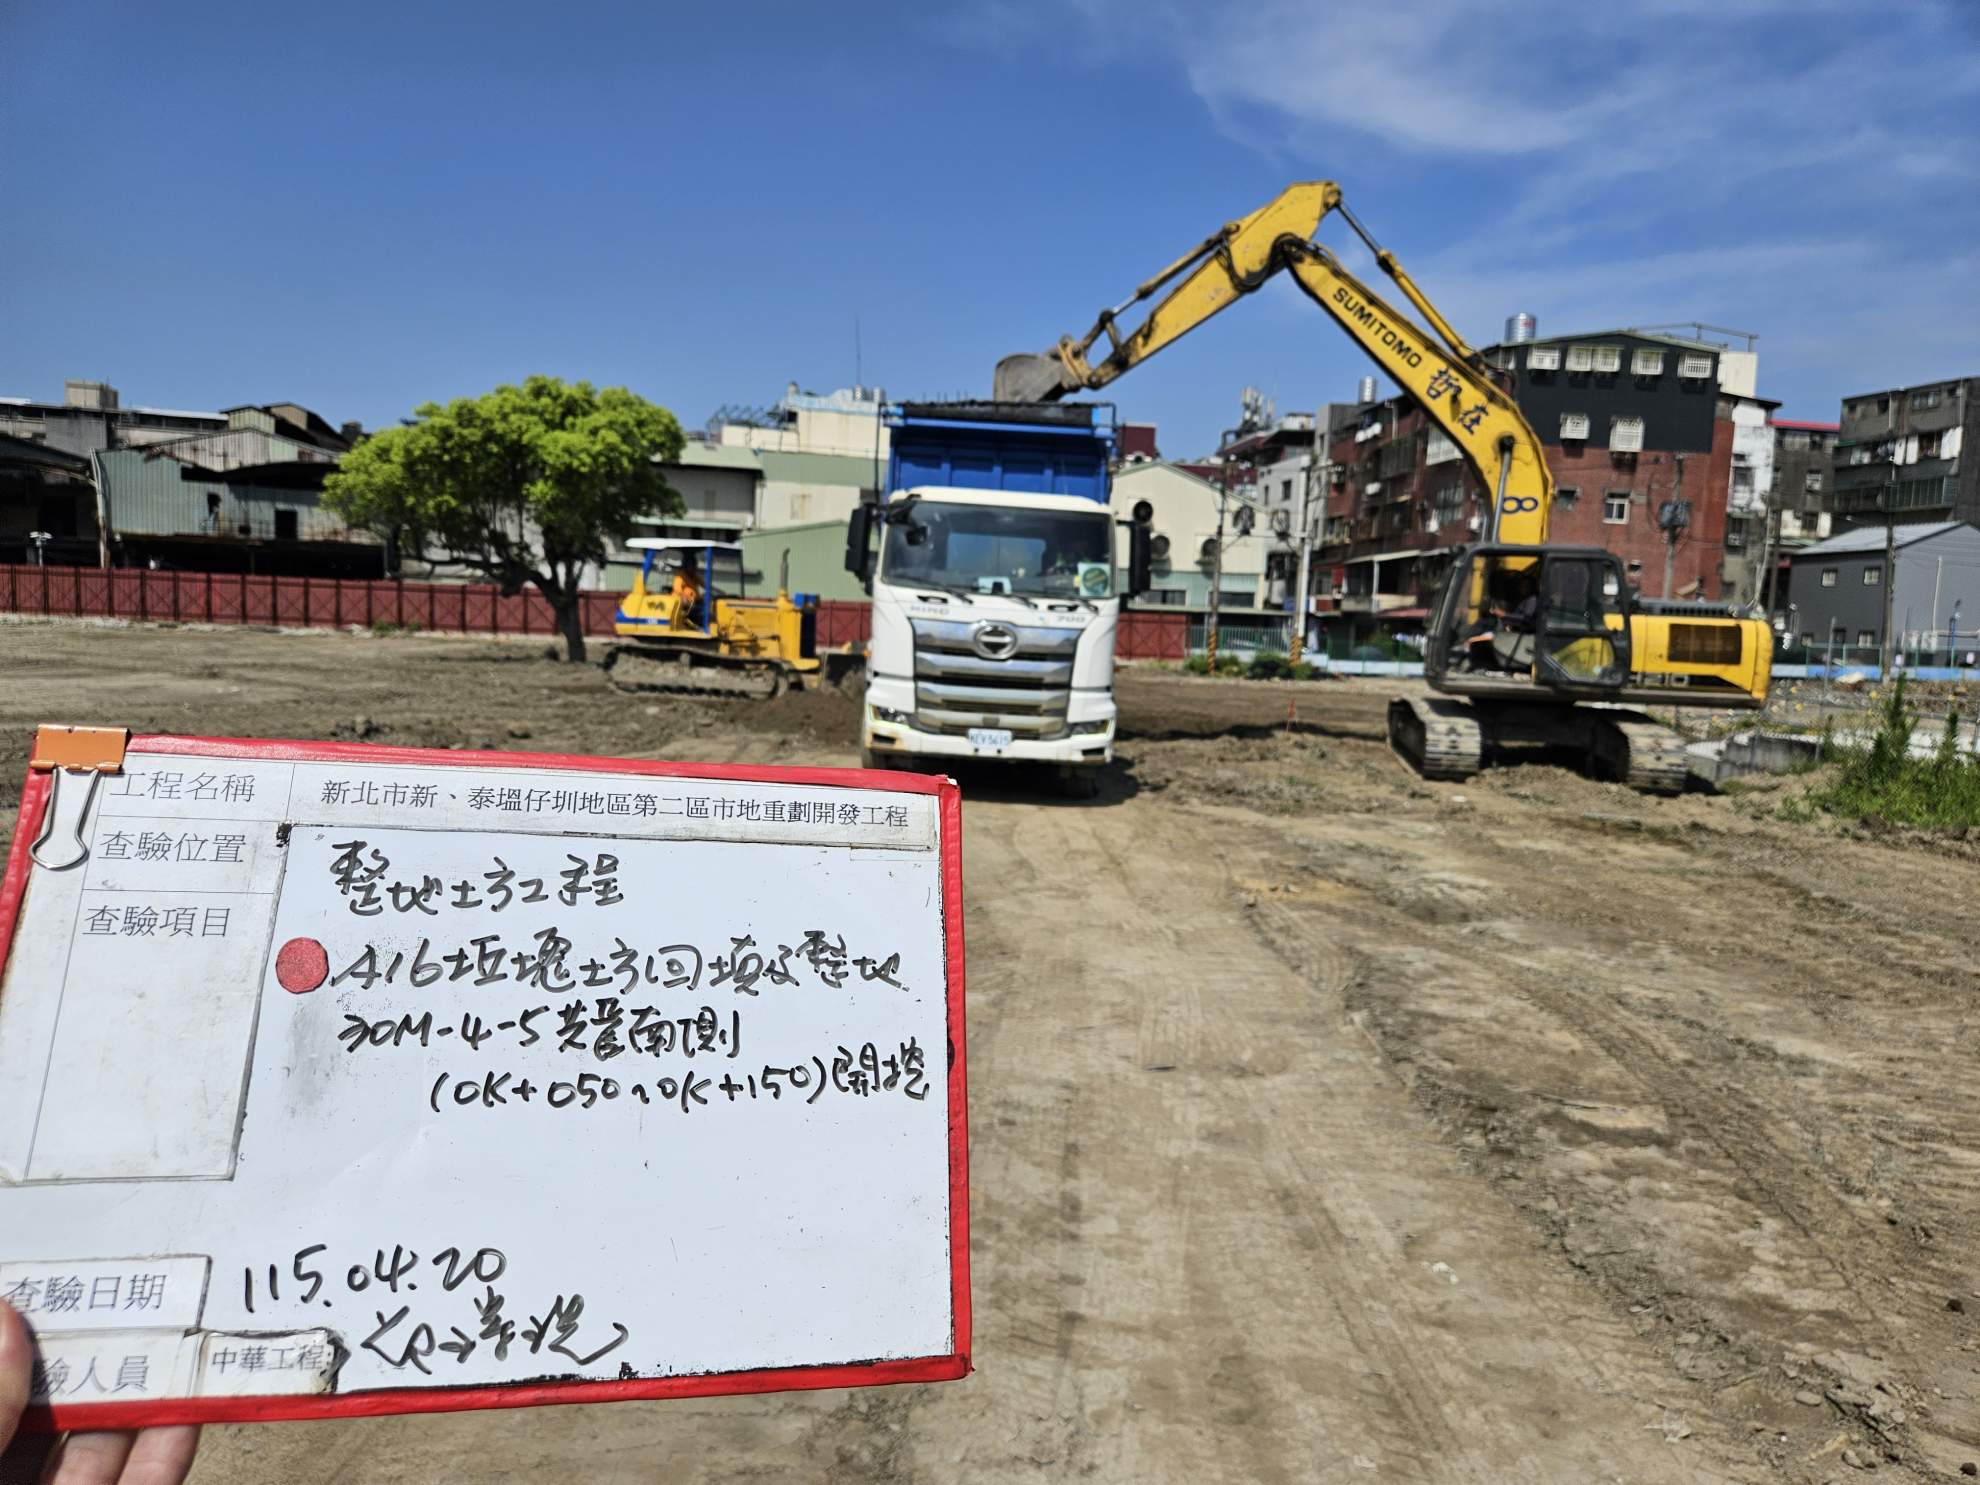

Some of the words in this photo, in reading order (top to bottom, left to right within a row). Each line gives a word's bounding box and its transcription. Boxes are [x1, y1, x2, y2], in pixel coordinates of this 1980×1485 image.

[1332, 287, 1423, 369] SUMITOMO
[109, 769, 256, 802] 工程名稱
[97, 831, 247, 864] 查驗位置
[330, 840, 625, 916] 整地土方工程
[82, 905, 232, 938] 查驗項目
[2, 1274, 168, 1314] 查驗日期
[244, 1243, 507, 1314] 115.04.20
[211, 1343, 330, 1376] 中華工程
